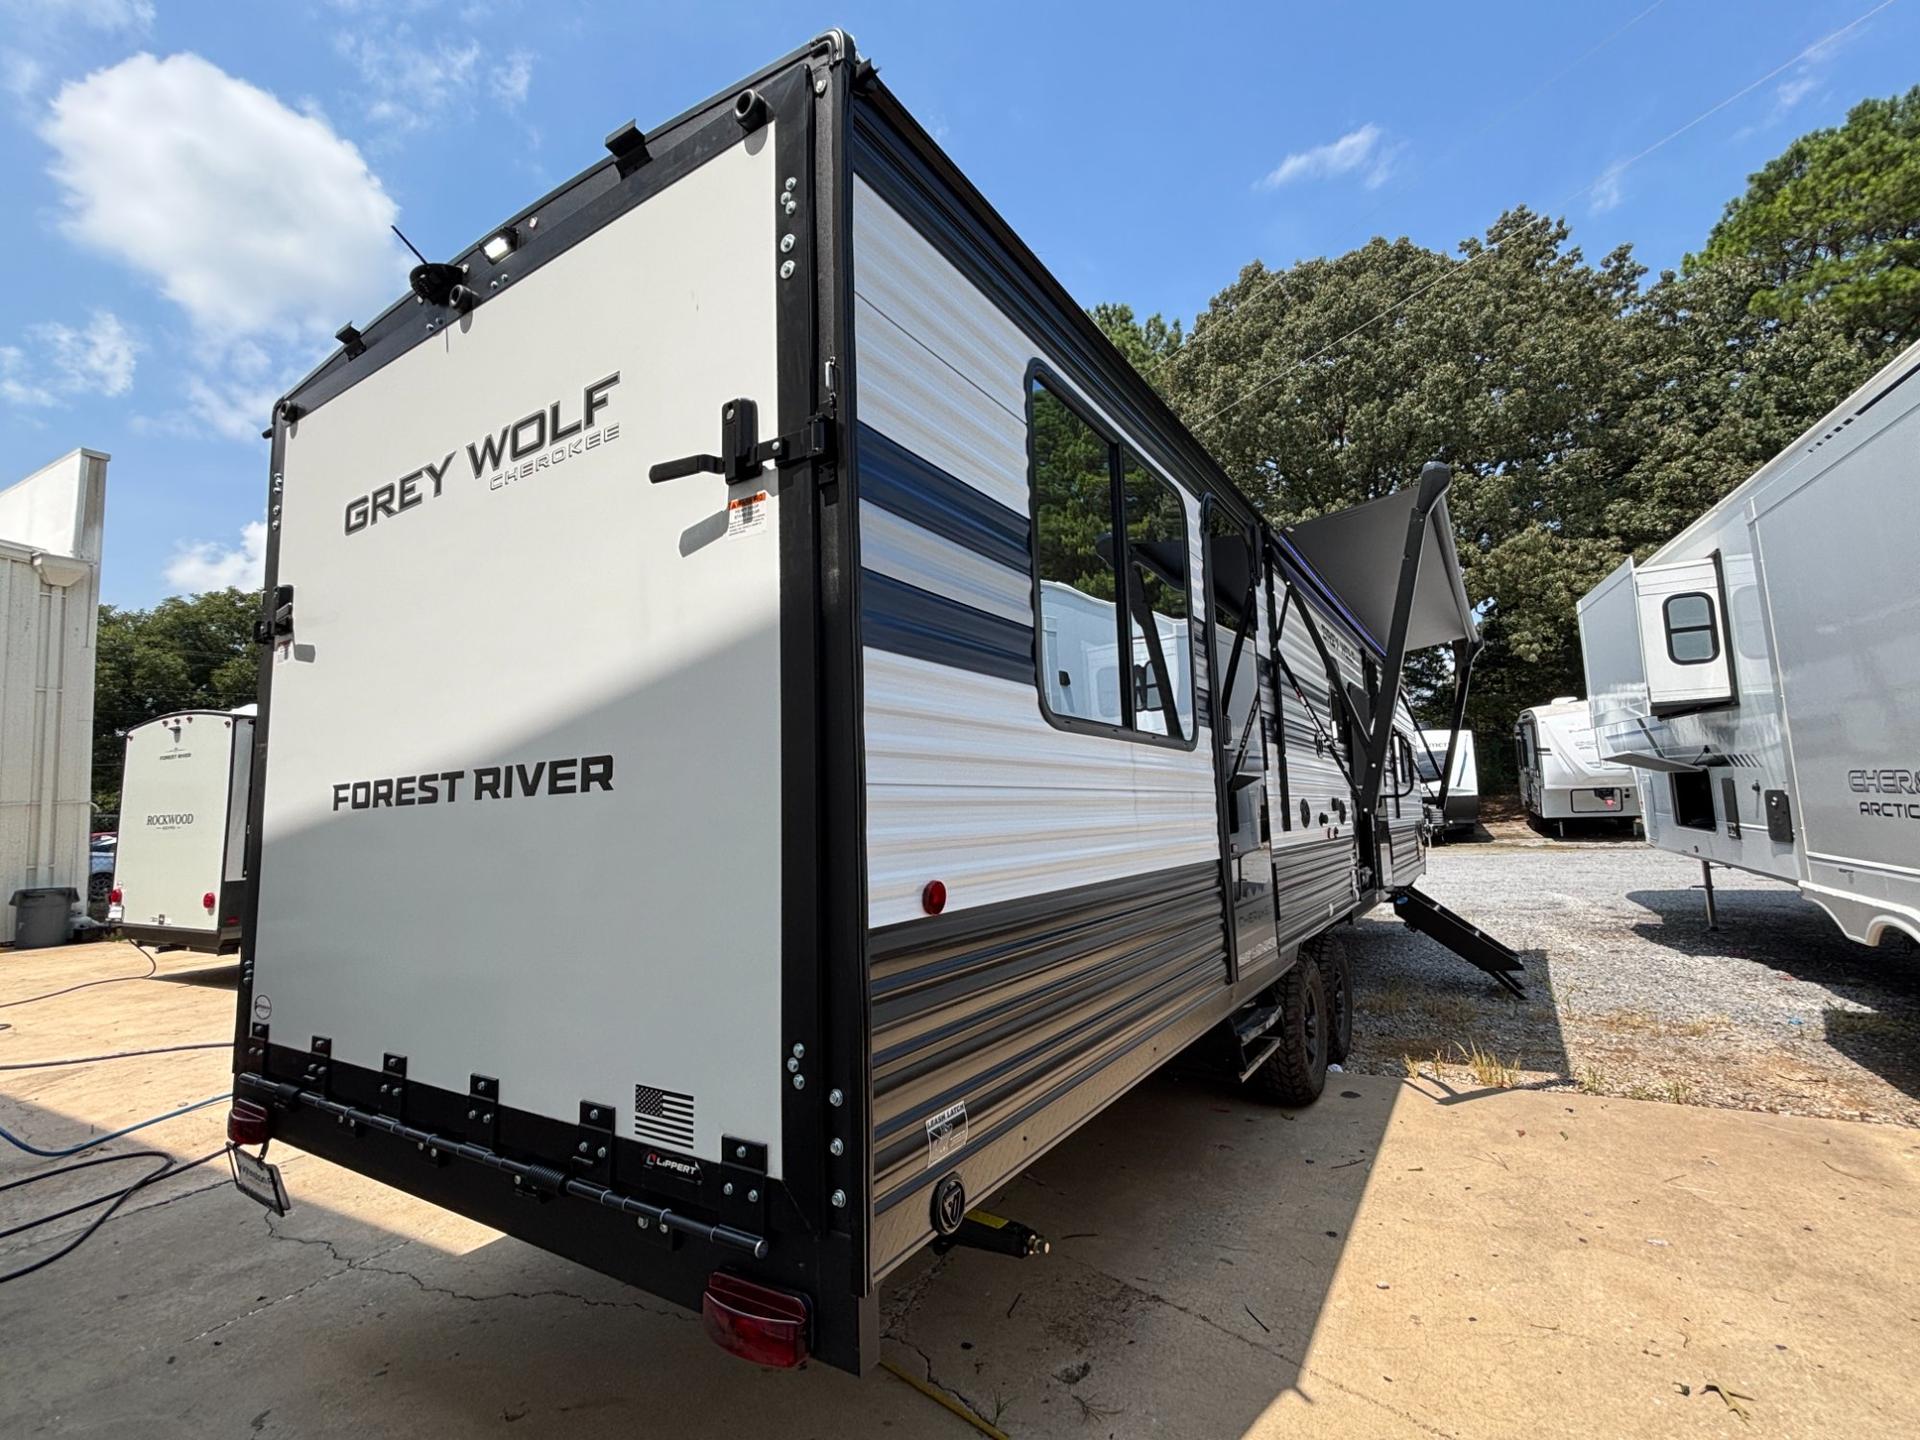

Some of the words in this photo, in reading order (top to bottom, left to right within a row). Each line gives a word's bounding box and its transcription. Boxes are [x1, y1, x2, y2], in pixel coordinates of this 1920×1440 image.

[344, 450, 457, 536] GREY
[466, 370, 621, 480] WOLF
[489, 423, 620, 491] CHEROKEE
[332, 770, 465, 811] FOREST
[473, 754, 614, 801] RIVER
[146, 813, 194, 826] ROCKWOOD
[1859, 801, 1920, 819] ARCTIC
[656, 1156, 697, 1175] LIPPERT
